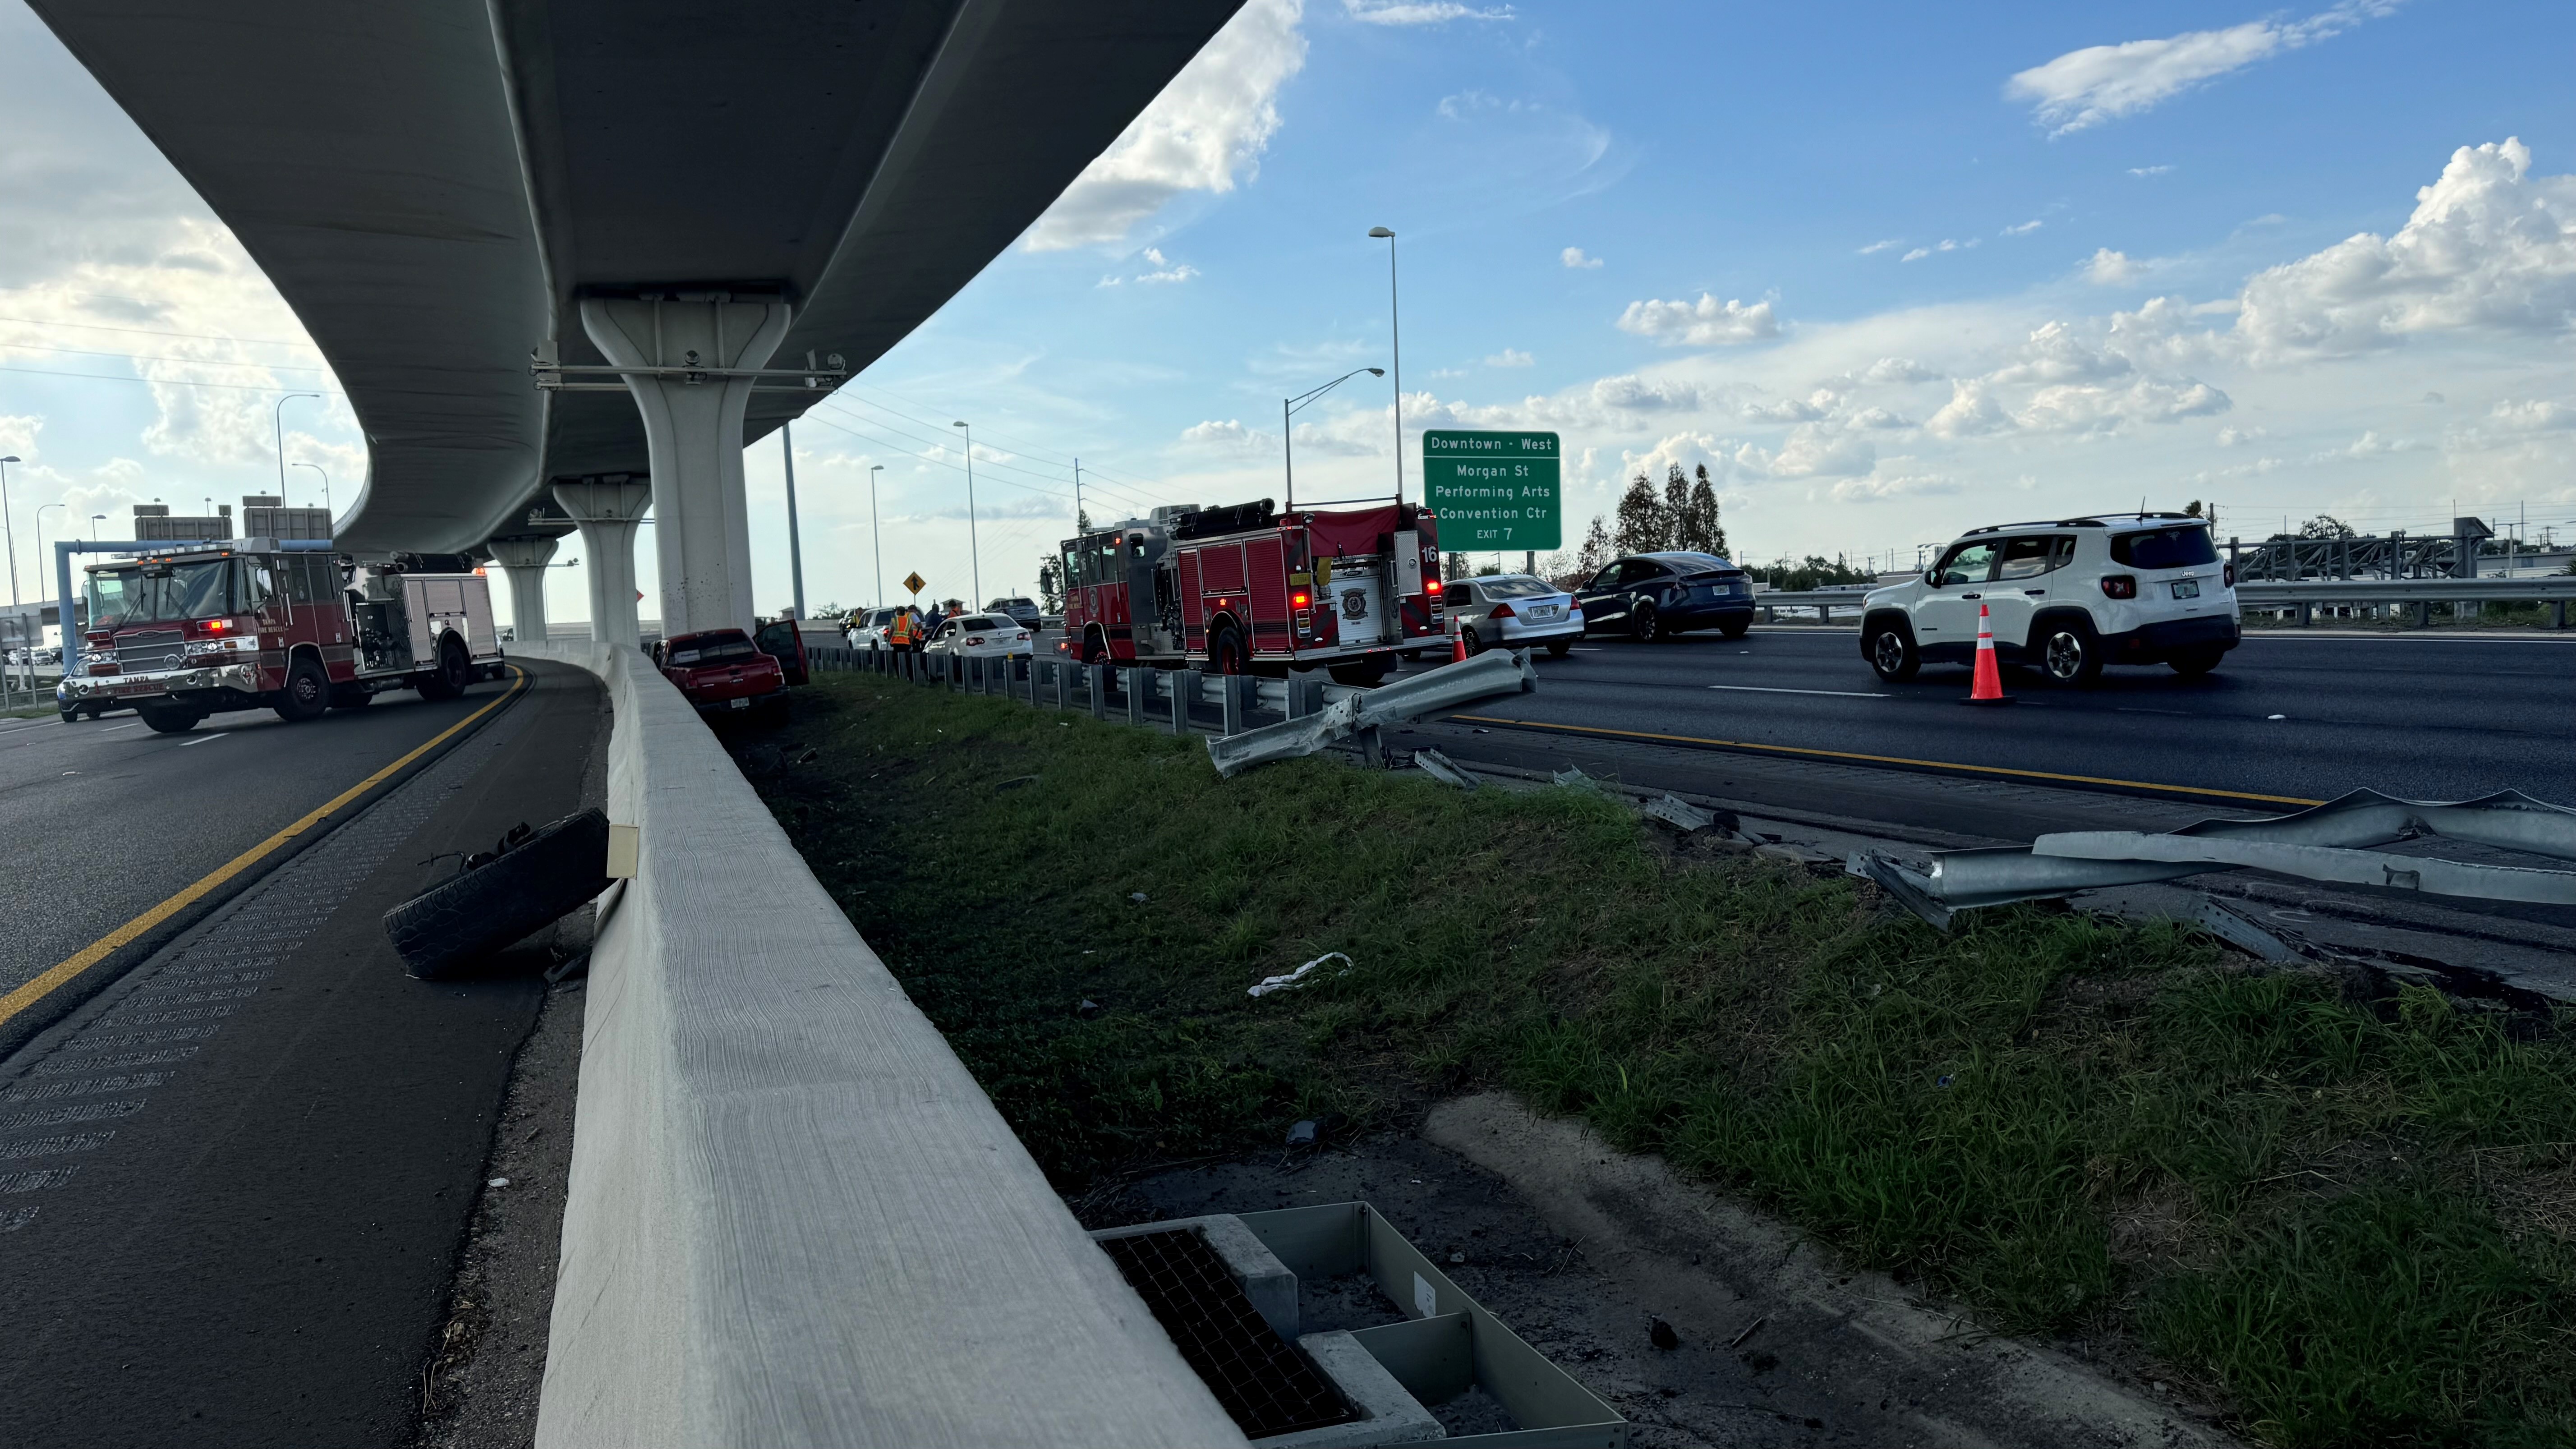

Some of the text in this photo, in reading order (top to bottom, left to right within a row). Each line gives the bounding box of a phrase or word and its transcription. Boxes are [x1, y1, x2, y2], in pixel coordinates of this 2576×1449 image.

[1431, 437, 1501, 450] Downtown
[1521, 438, 1551, 450] West
[1457, 465, 1528, 479] Morgan St
[1436, 485, 1550, 500] Performing Arts
[1440, 507, 1547, 519] Convention Ctr
[1477, 528, 1512, 540] EXIT 7
[1421, 546, 1437, 563] 16
[283, 575, 287, 589] 1
[123, 676, 150, 685] TAMPA
[94, 681, 101, 694] 1
[113, 683, 164, 694] FIRE RESCUE
